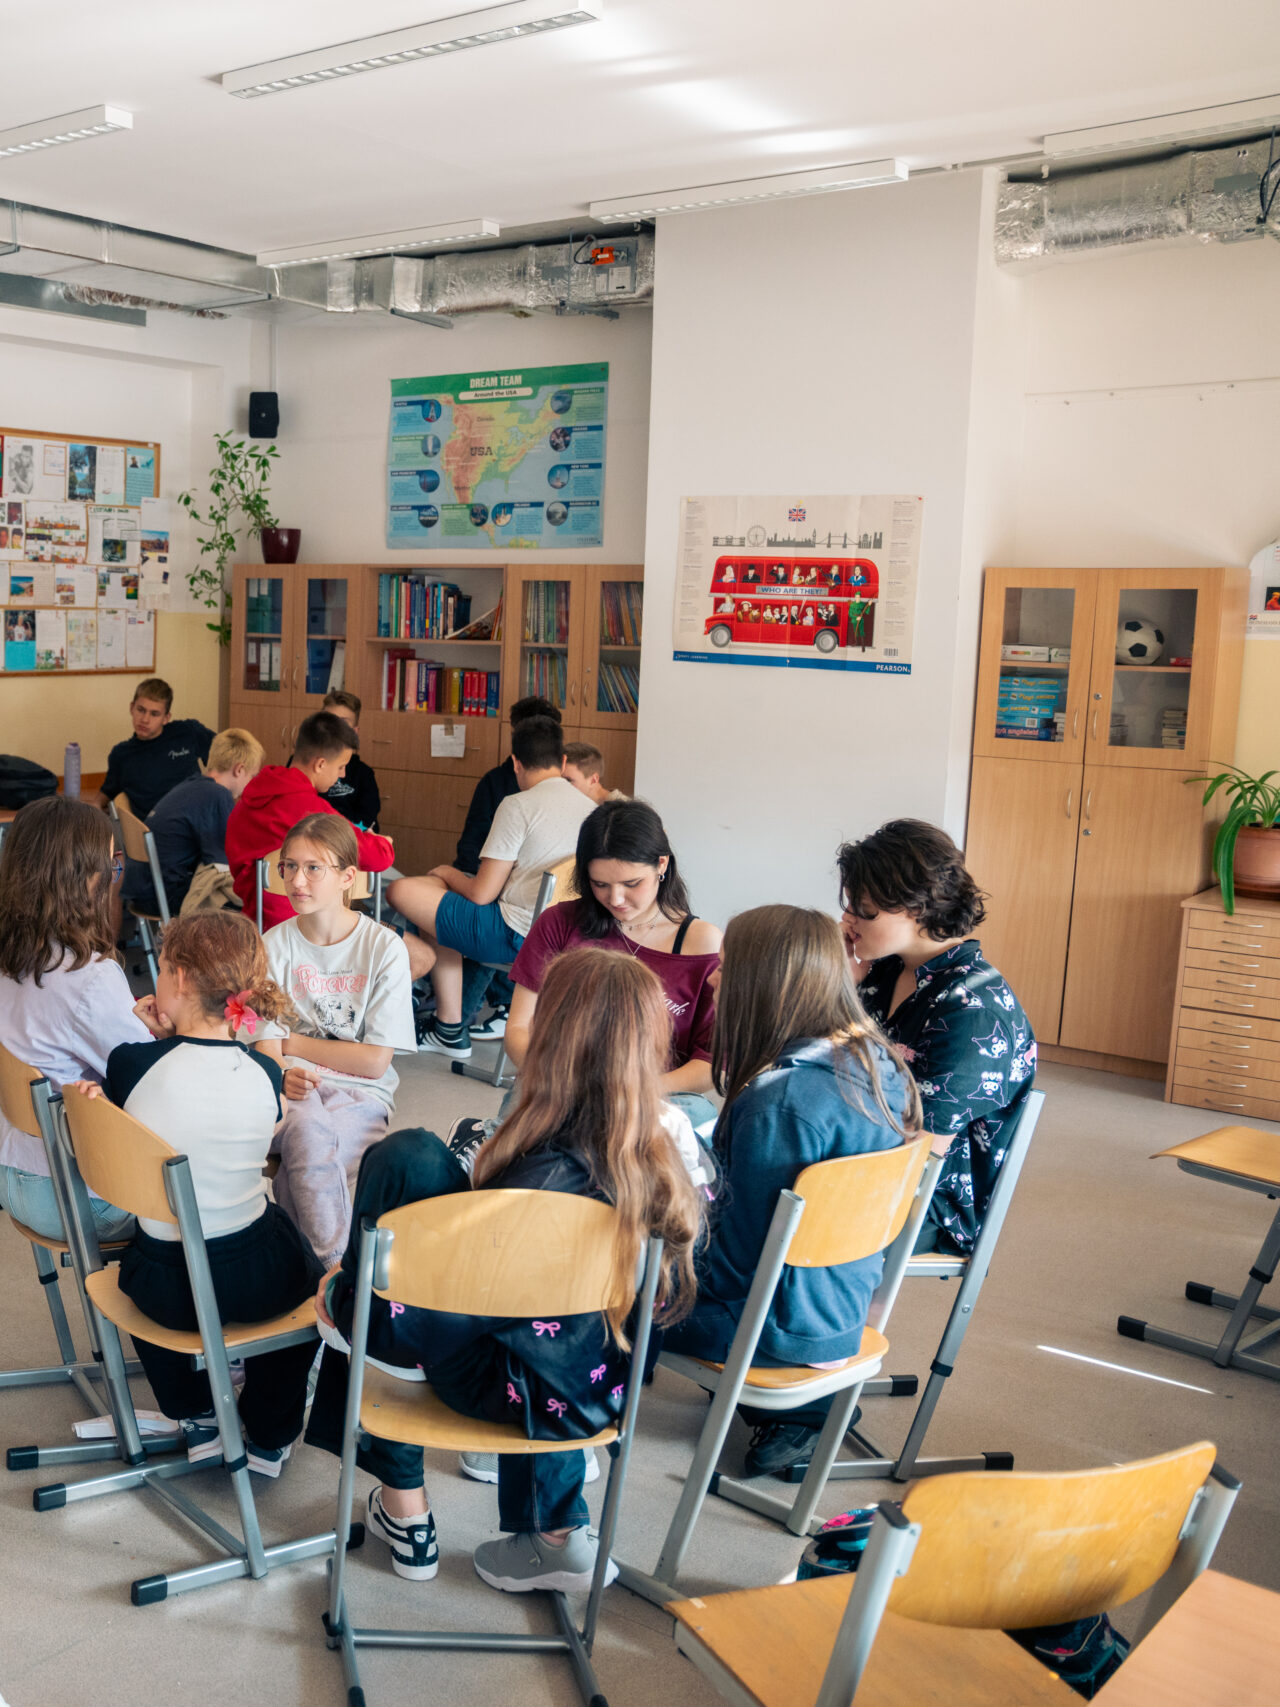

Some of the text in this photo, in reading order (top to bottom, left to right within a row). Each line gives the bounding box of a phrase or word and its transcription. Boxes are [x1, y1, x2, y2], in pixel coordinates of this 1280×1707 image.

[470, 374, 522, 388] DREAM TEAM
[470, 446, 493, 456] USA
[876, 664, 908, 672] PEARSON
[292, 964, 368, 1000] Forever
